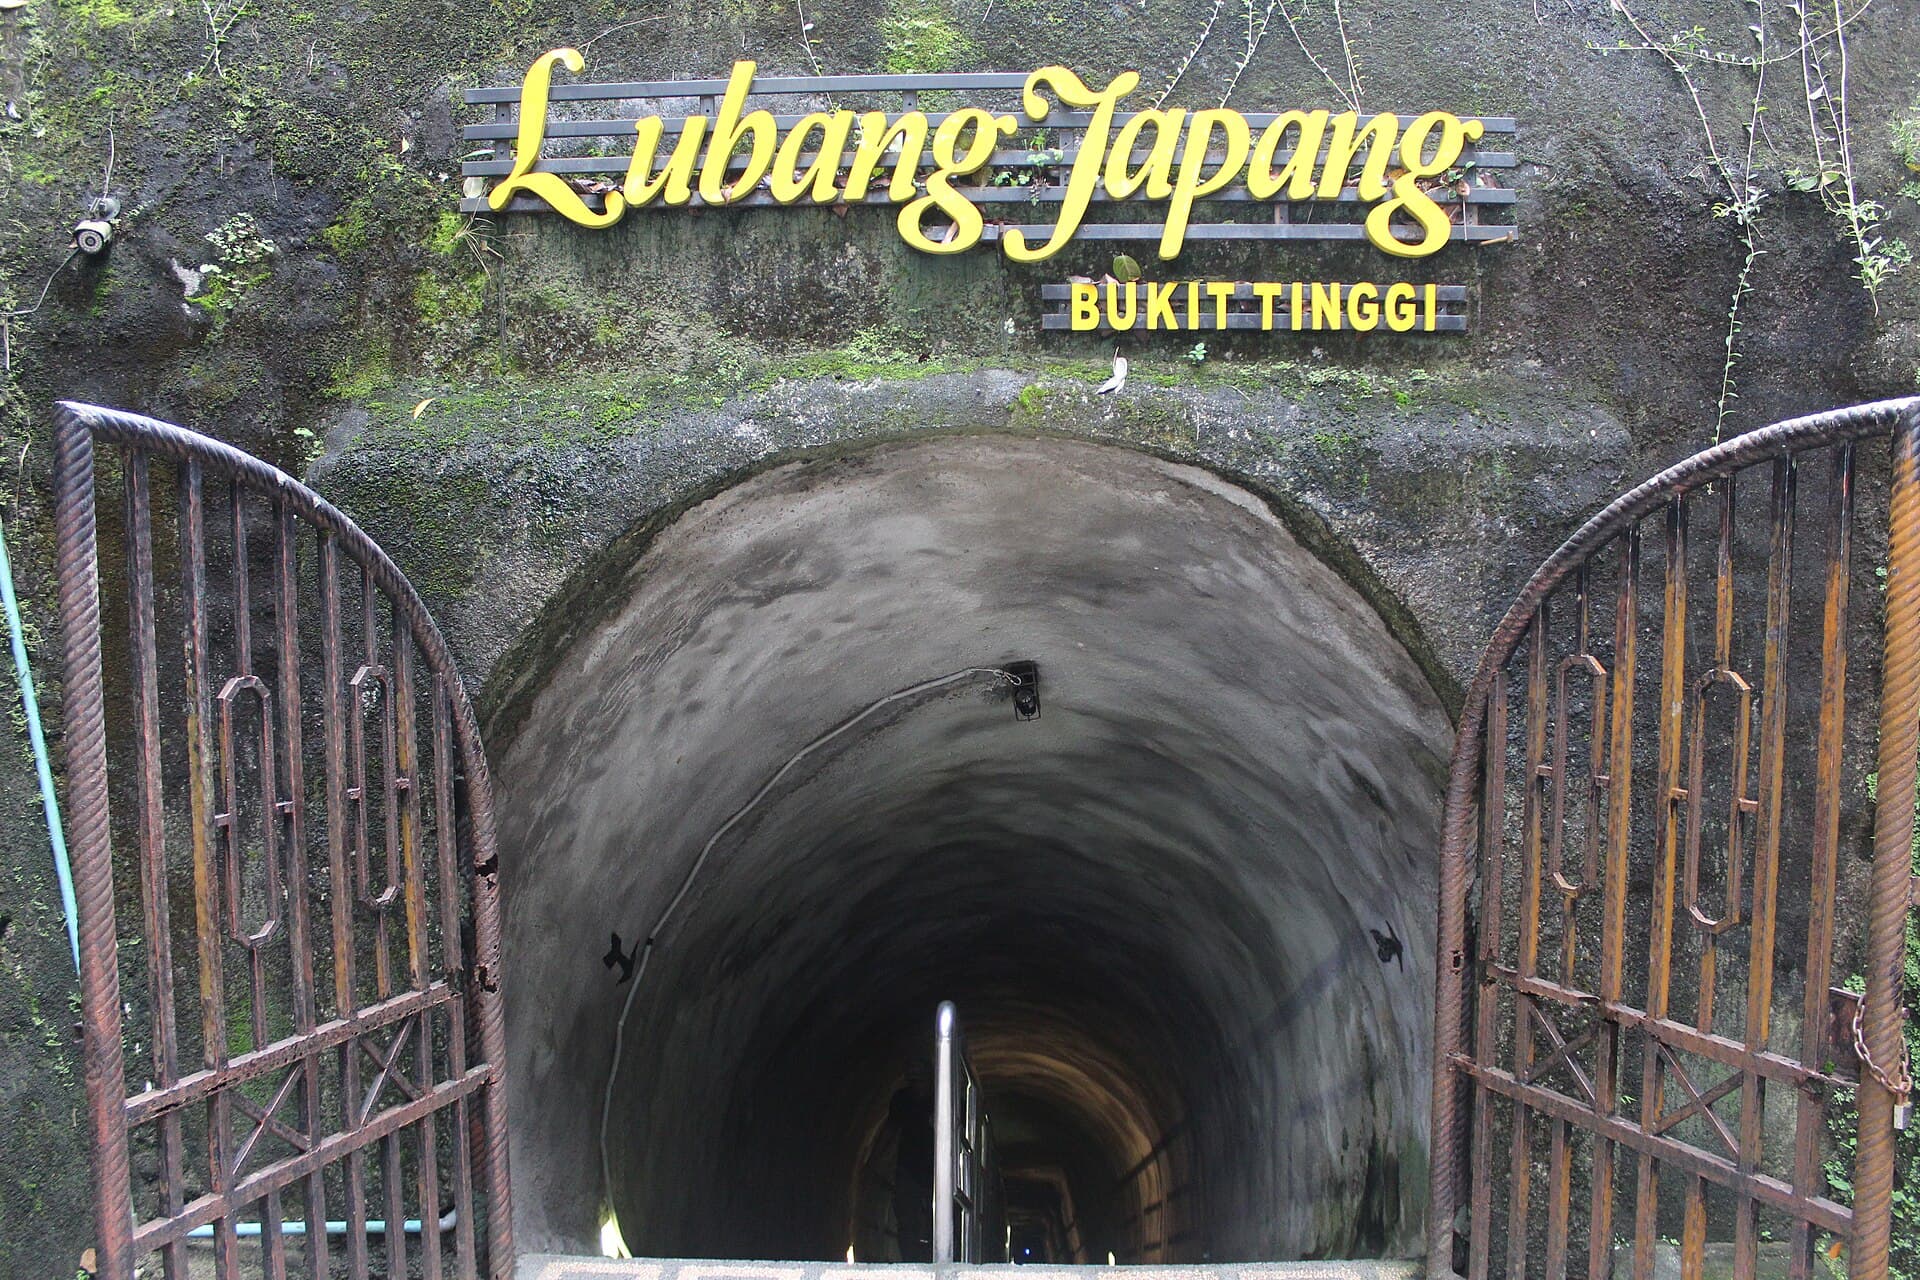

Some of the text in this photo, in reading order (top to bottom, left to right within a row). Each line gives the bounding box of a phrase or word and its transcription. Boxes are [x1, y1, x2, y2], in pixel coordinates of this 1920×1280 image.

[488, 47, 1484, 263] Lubang Japang
[1070, 281, 1437, 332] BUKIT TINGGI
